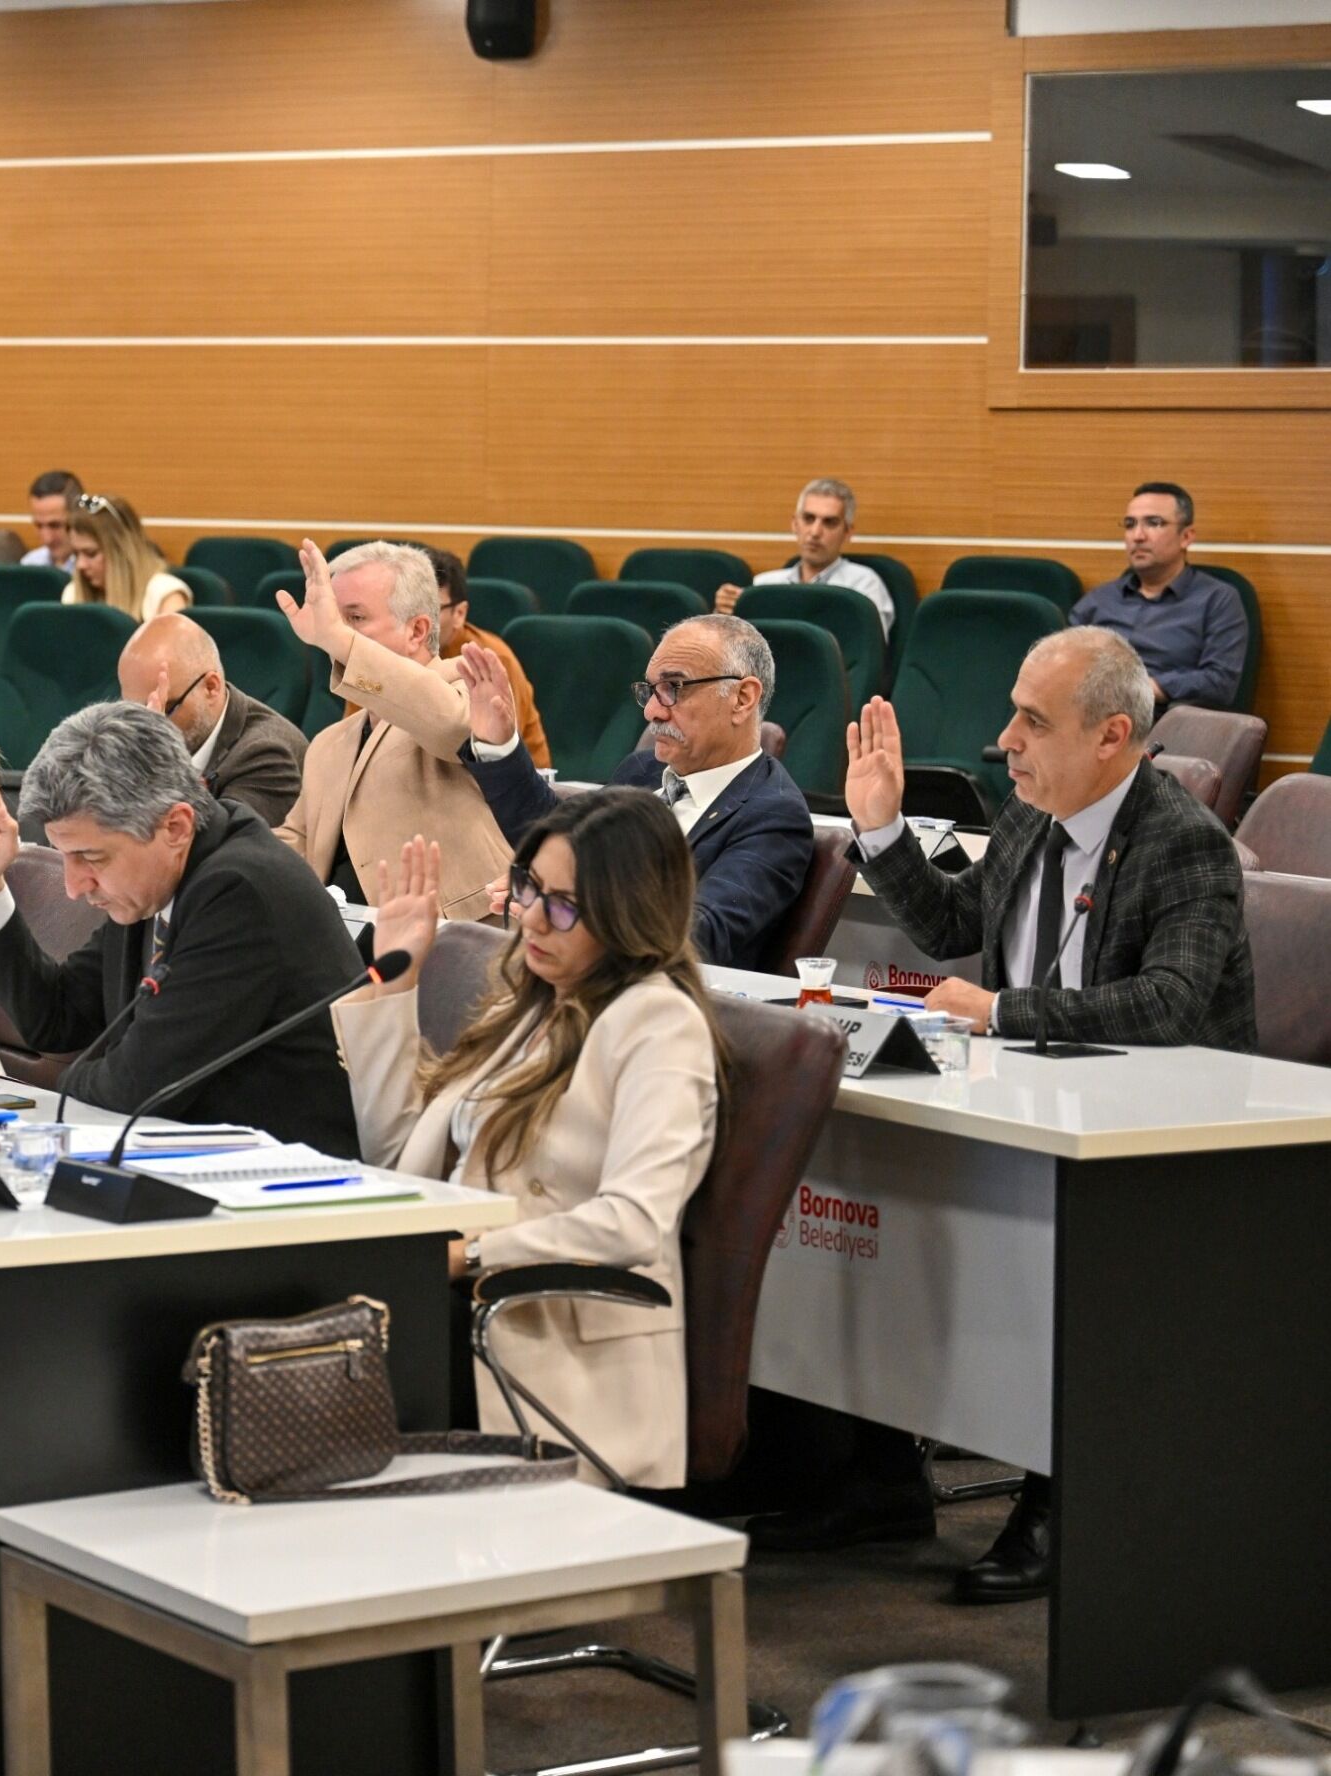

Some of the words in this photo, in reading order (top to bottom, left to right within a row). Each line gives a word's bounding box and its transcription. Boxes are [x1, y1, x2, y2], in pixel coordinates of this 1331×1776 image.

[889, 964, 947, 986] Bornov
[799, 1185, 879, 1229] Bornova
[799, 1220, 879, 1261] Belediyesi
